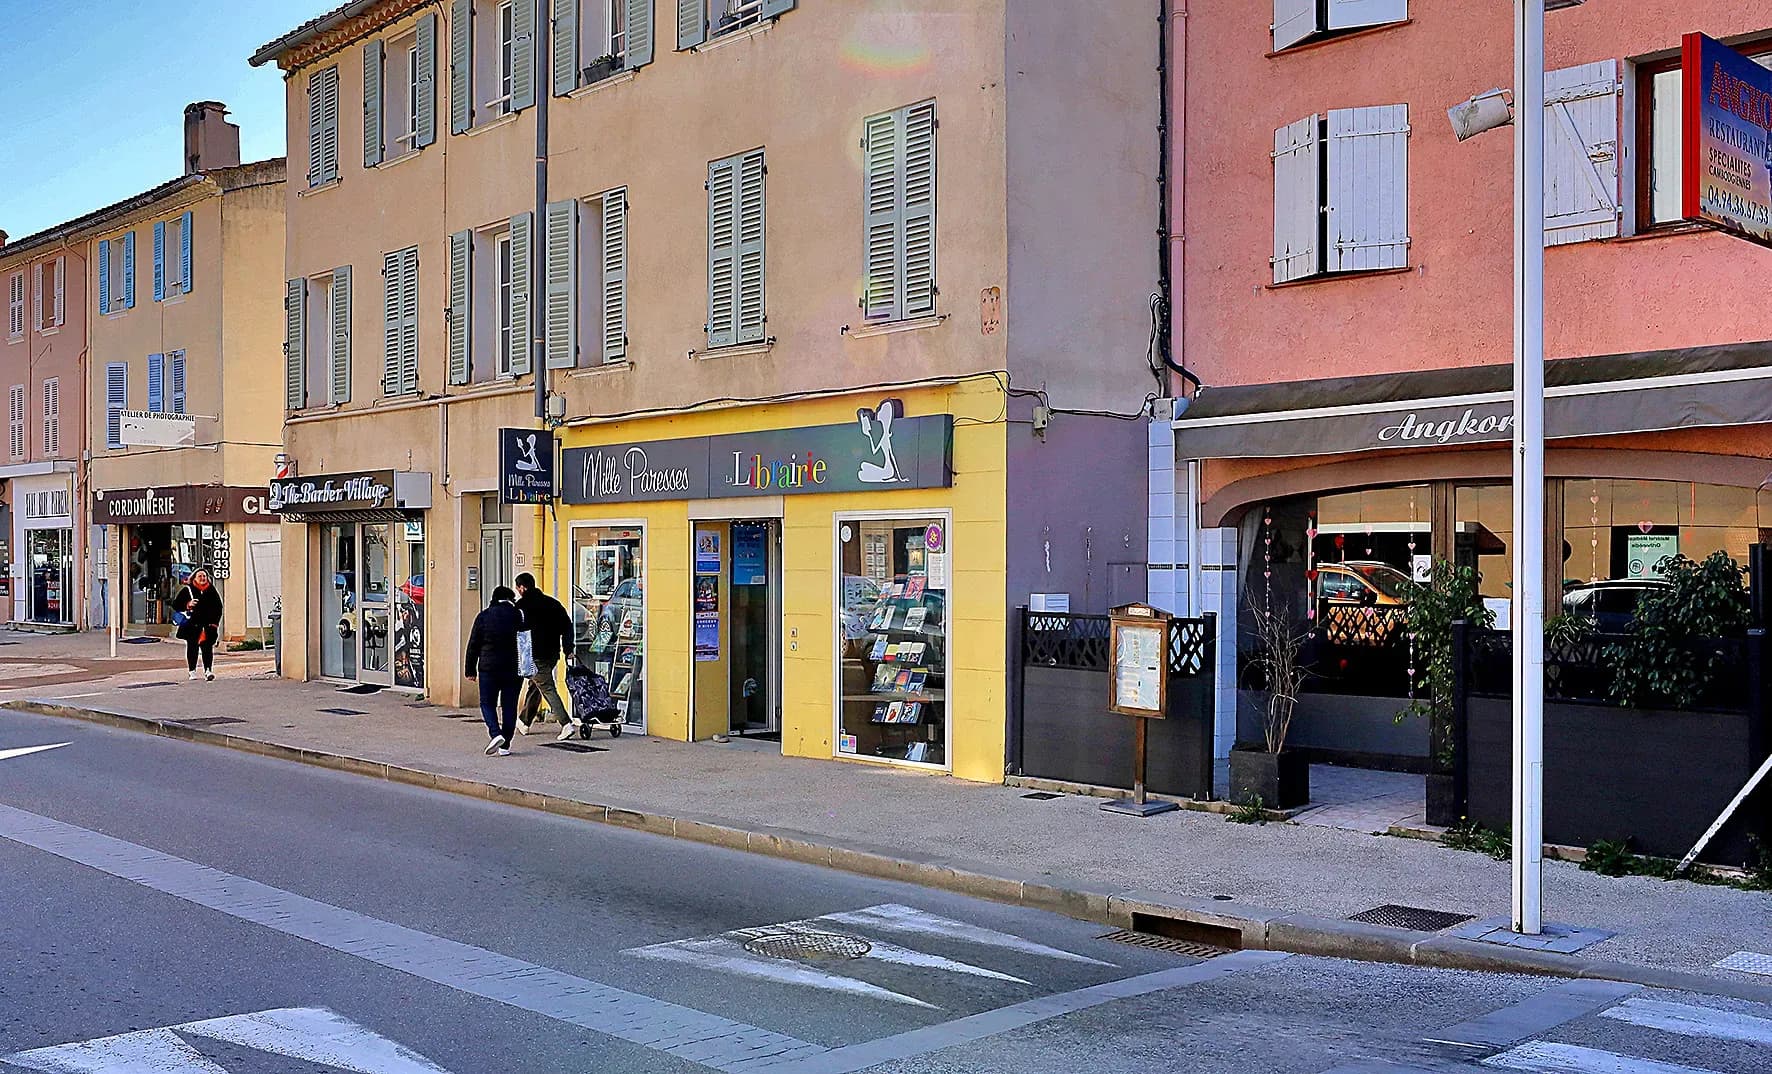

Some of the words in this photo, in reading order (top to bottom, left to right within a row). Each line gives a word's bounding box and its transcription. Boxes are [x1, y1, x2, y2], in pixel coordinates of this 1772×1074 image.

[1709, 117, 1766, 159] RESTAURANT
[121, 411, 144, 419] ATELIER
[152, 412, 194, 421] PHOTOGRAPHIE
[583, 450, 622, 498] Mille
[624, 447, 689, 495] Paresses
[733, 451, 827, 490] Librairie
[281, 483, 302, 505] The
[300, 480, 344, 503] Barber
[343, 476, 390, 508] Village
[109, 497, 175, 516] CORDONNERIE
[213, 530, 229, 540] 04
[213, 540, 229, 550] 94
[213, 550, 229, 560] 00
[213, 559, 229, 568] 33
[213, 570, 229, 579] 68
